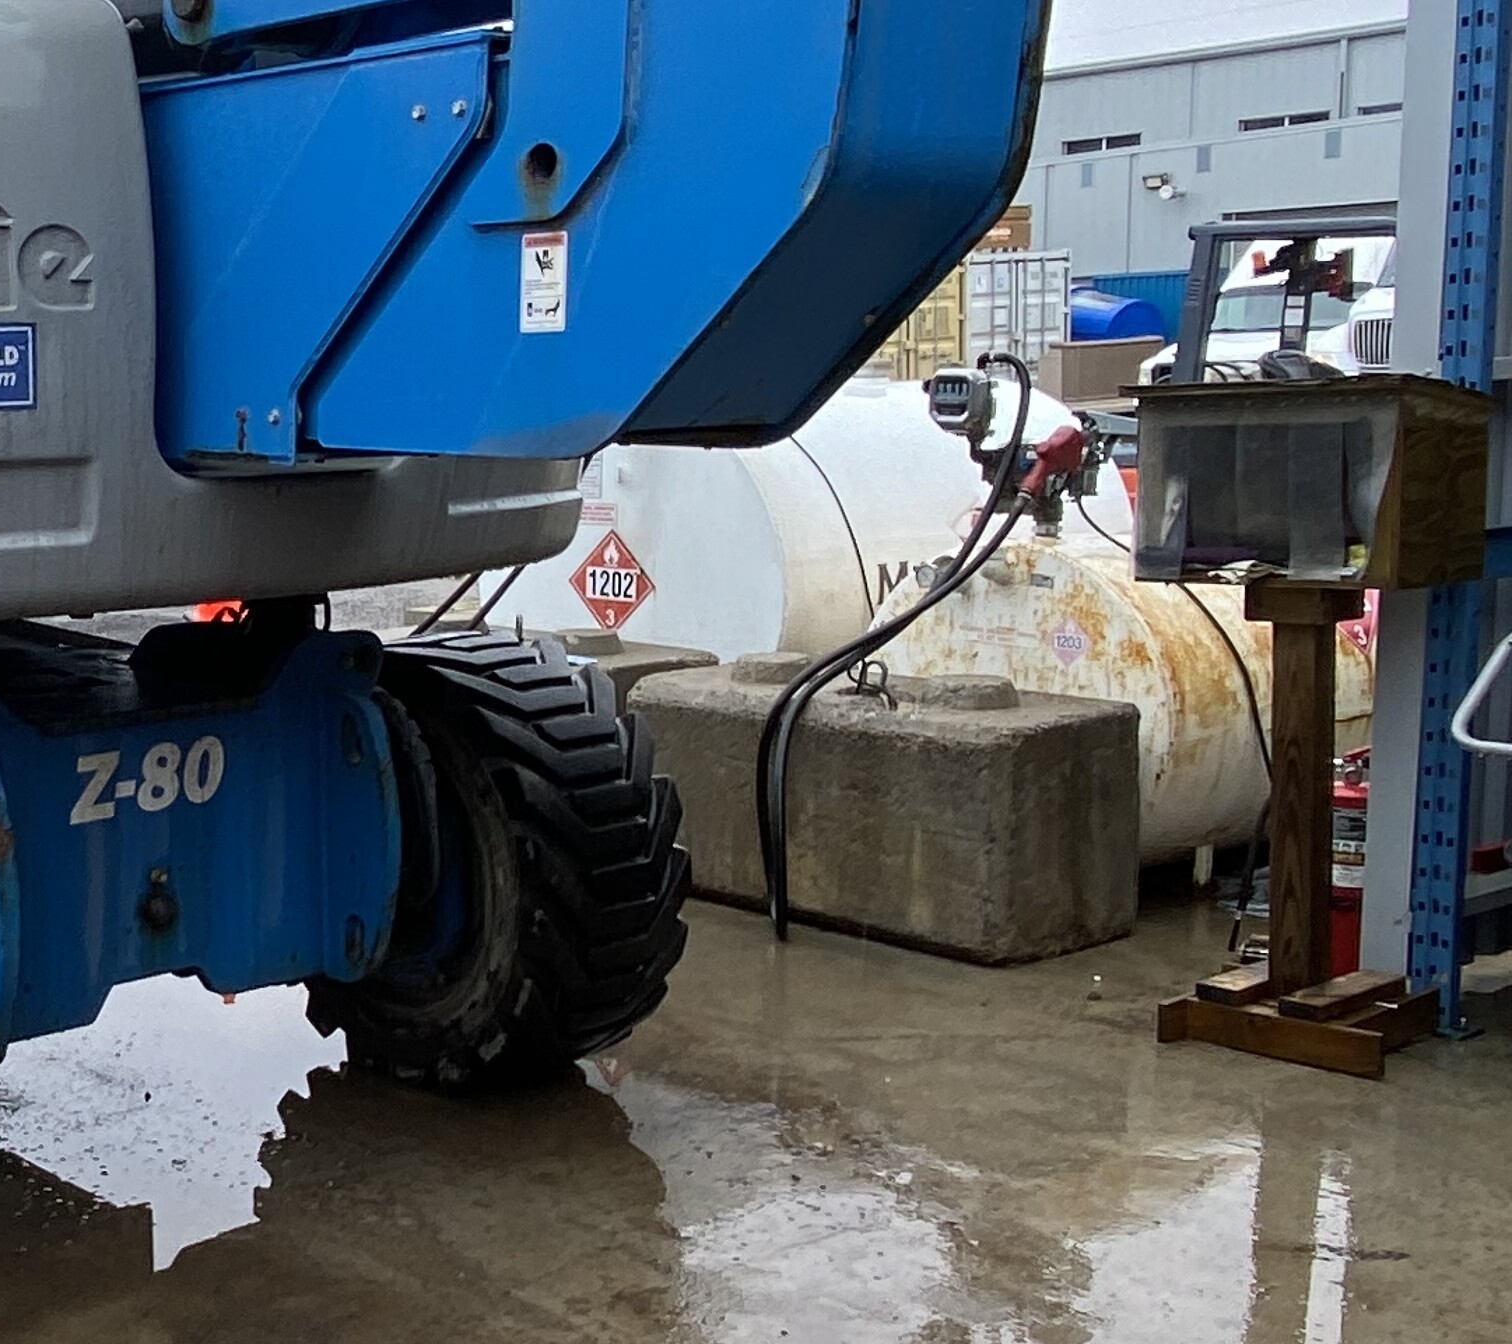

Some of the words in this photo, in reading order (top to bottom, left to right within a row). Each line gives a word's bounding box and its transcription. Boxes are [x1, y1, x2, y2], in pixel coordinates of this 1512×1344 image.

[589, 569, 635, 599] 1202
[604, 608, 616, 627] 3
[70, 735, 224, 825] Z-80
